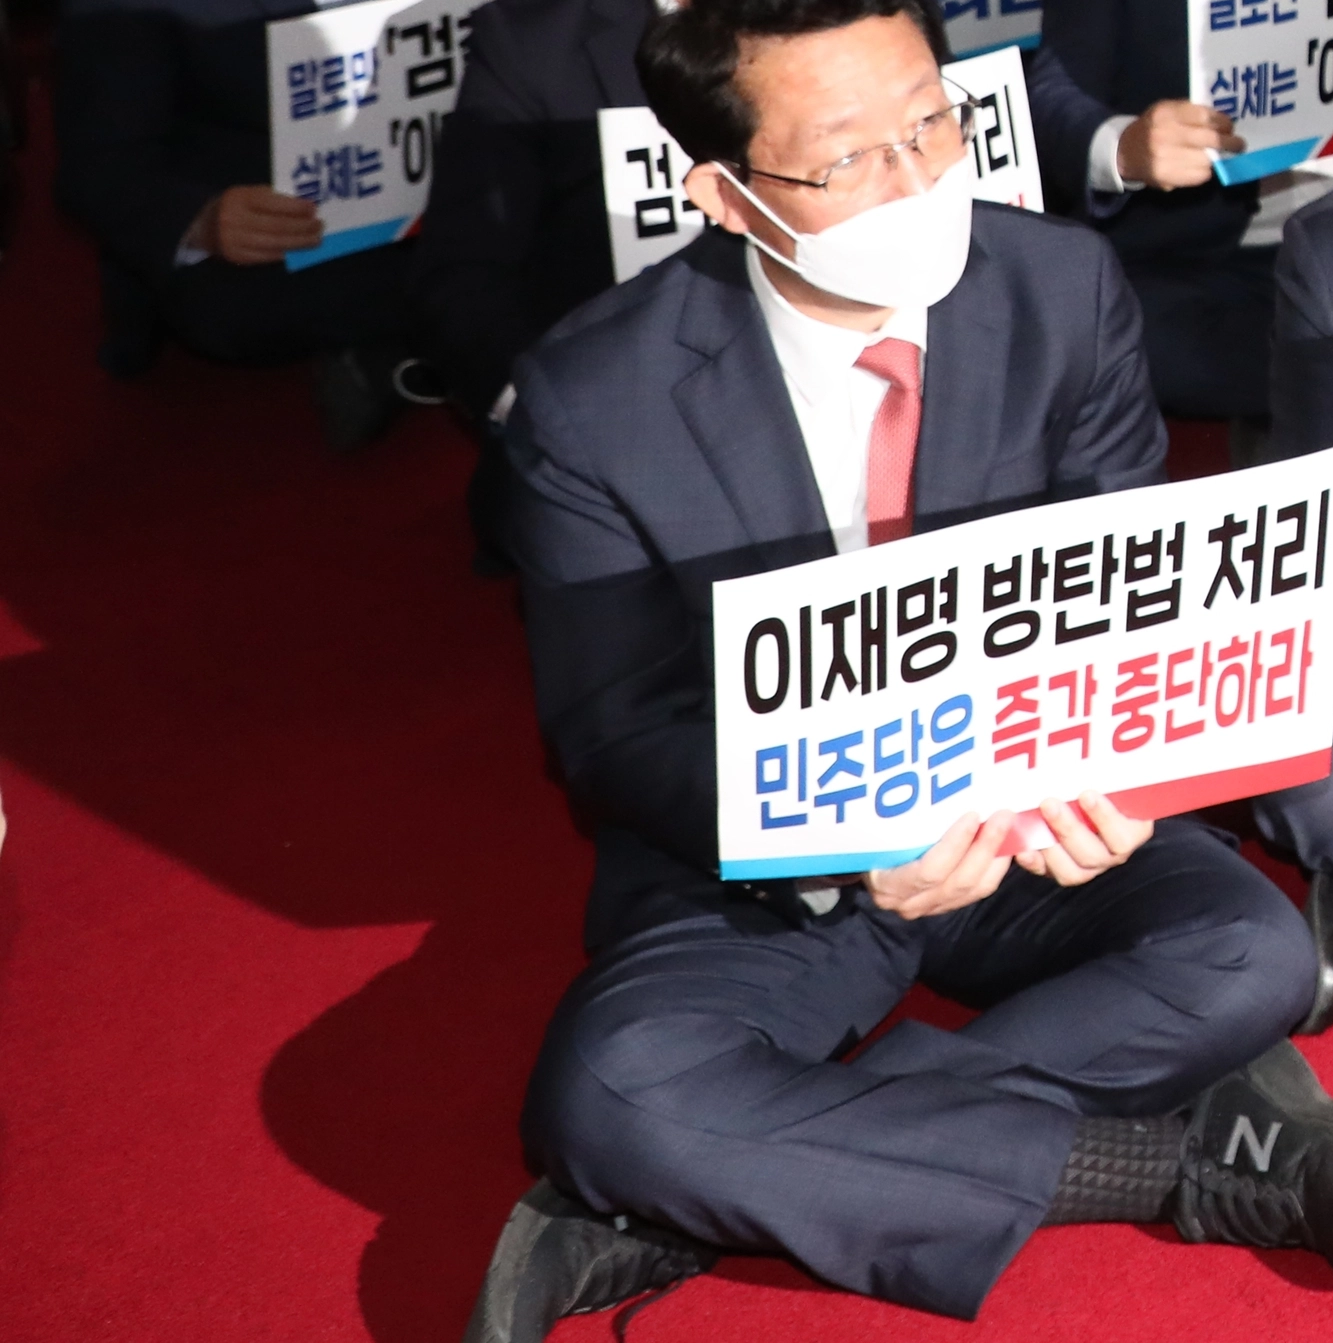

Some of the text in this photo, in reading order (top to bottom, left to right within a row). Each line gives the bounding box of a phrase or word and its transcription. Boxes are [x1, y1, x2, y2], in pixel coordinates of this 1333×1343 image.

[288, 47, 378, 119] 말로만
[1211, 62, 1297, 123] 실체는
[293, 144, 382, 203] 실체는
[743, 489, 1331, 714] 이재명 방탄법 처리
[756, 619, 1314, 831] 민주당은 즉각 중단하라
[1223, 1115, 1283, 1172] N
